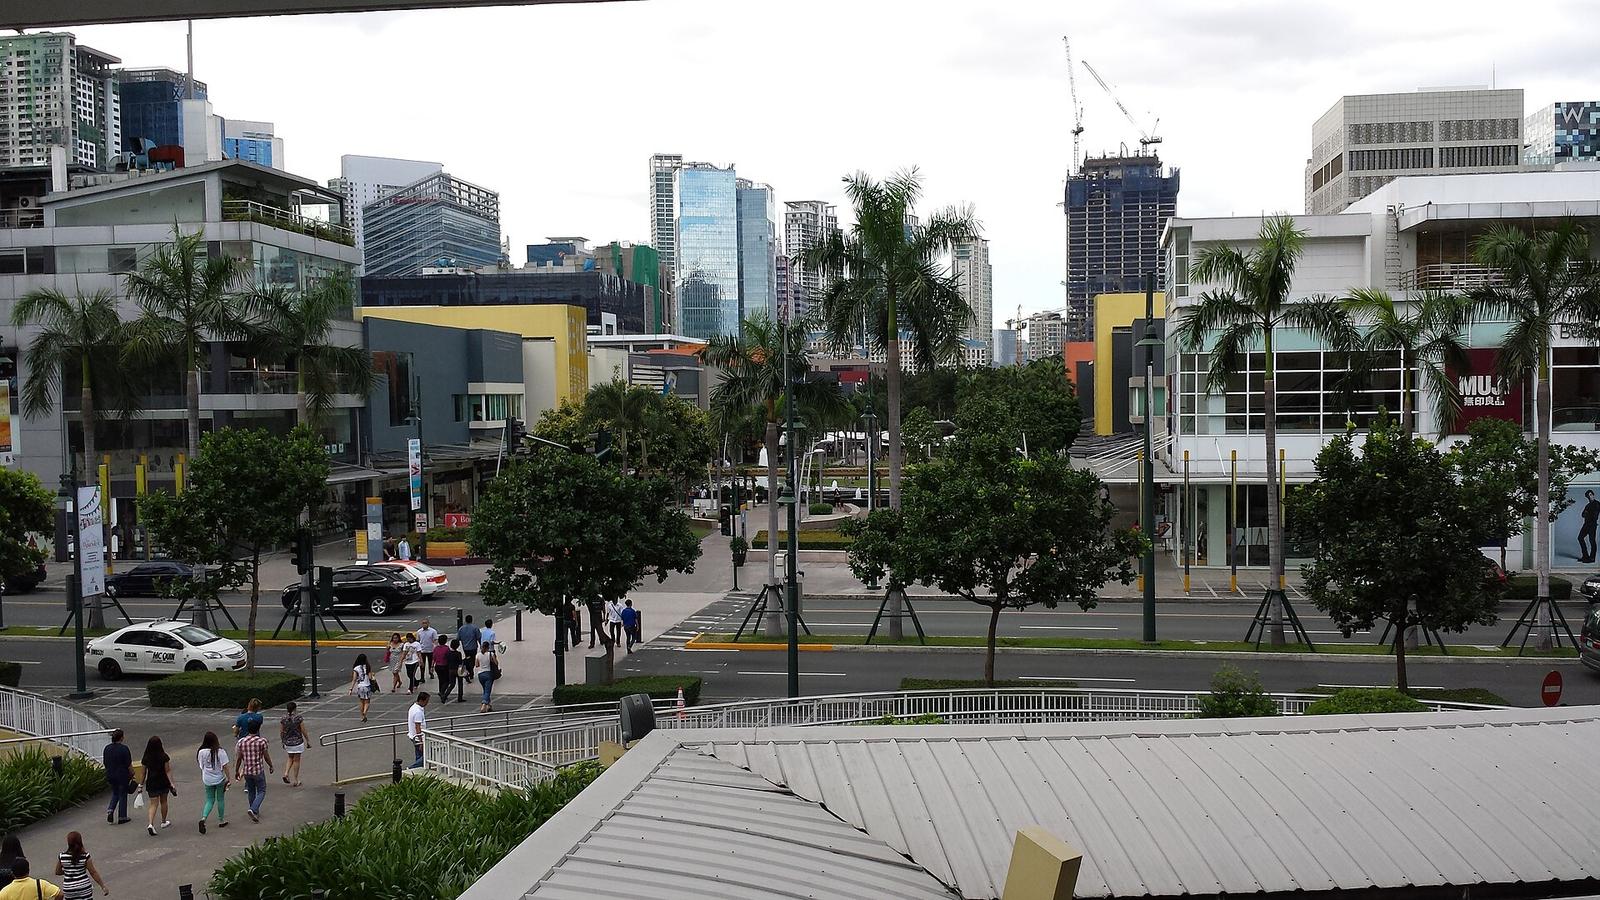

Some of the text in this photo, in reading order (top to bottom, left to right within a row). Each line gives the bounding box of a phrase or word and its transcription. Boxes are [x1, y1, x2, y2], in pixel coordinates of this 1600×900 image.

[1560, 107, 1585, 124] W
[1463, 395, 1505, 406] 無印良品
